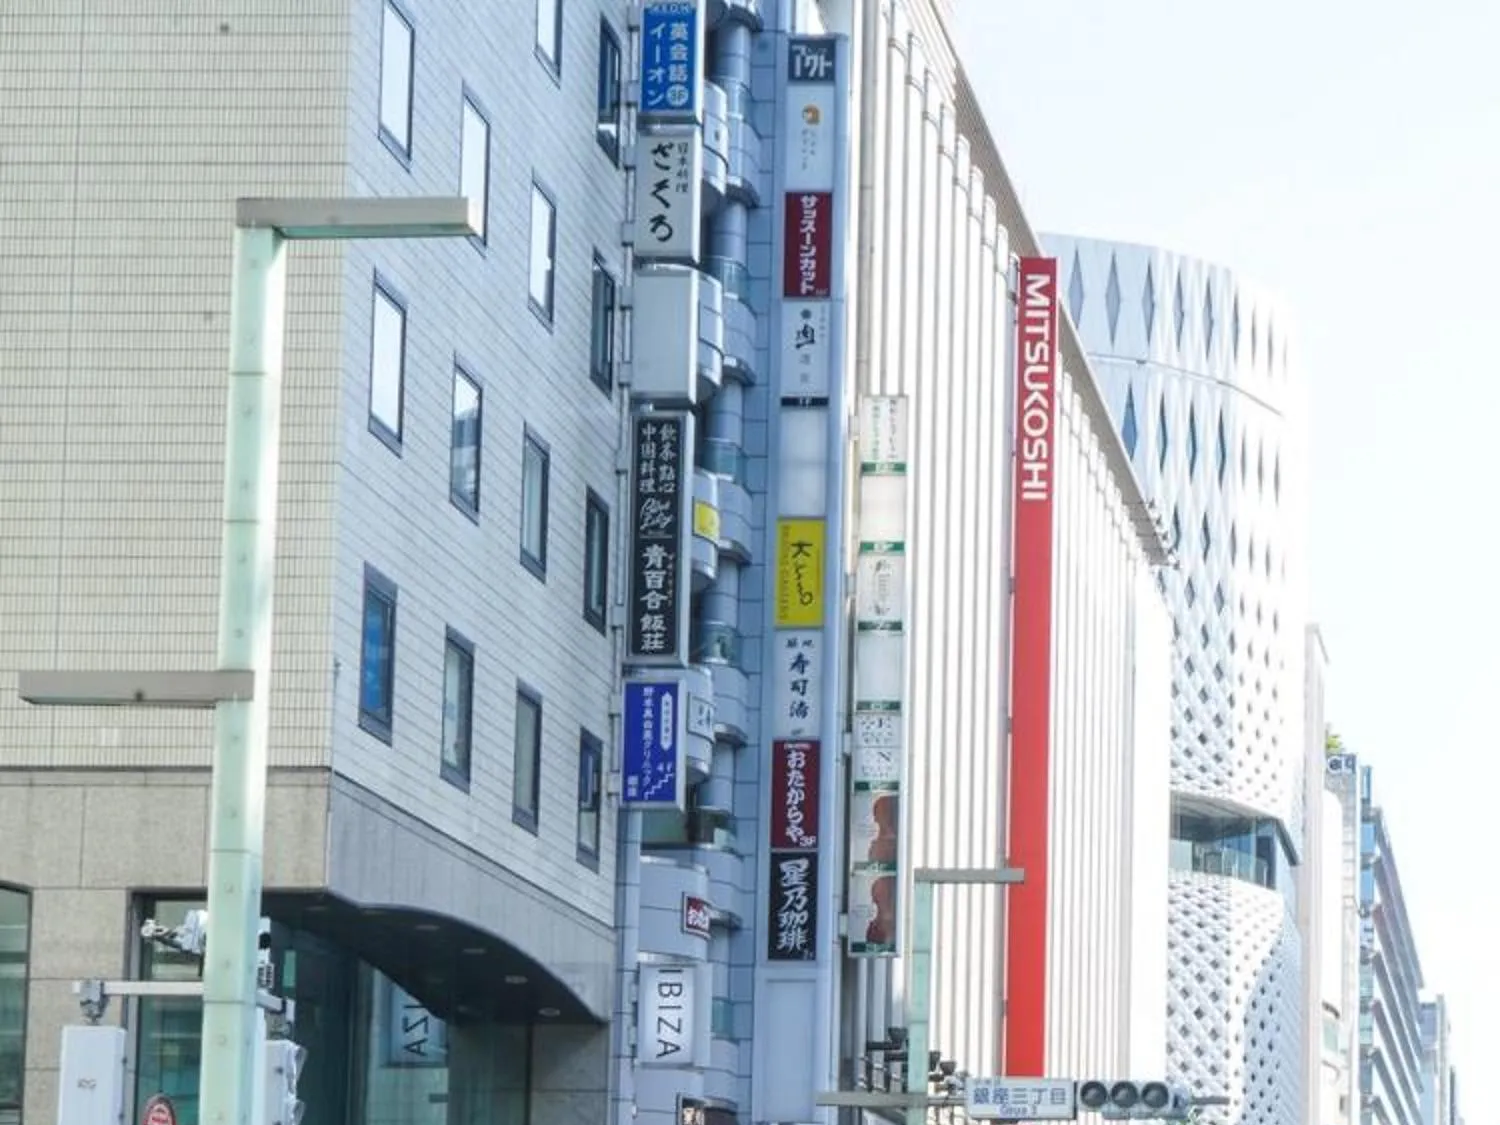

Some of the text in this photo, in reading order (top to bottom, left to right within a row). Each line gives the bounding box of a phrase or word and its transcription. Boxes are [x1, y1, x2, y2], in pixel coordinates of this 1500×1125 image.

[647, 22, 666, 106] イーオン
[670, 22, 689, 82] 英会話
[650, 142, 674, 242] ざくろ
[1022, 274, 1051, 501] MITSUKOSHI
[640, 544, 669, 652] 青百合飯荘
[786, 751, 806, 843] おたからや
[800, 836, 816, 847] 3F
[777, 858, 809, 951] 星乃珈琲
[656, 968, 684, 1059] IBIZA
[973, 1087, 1067, 1105] 銀座三丁目
